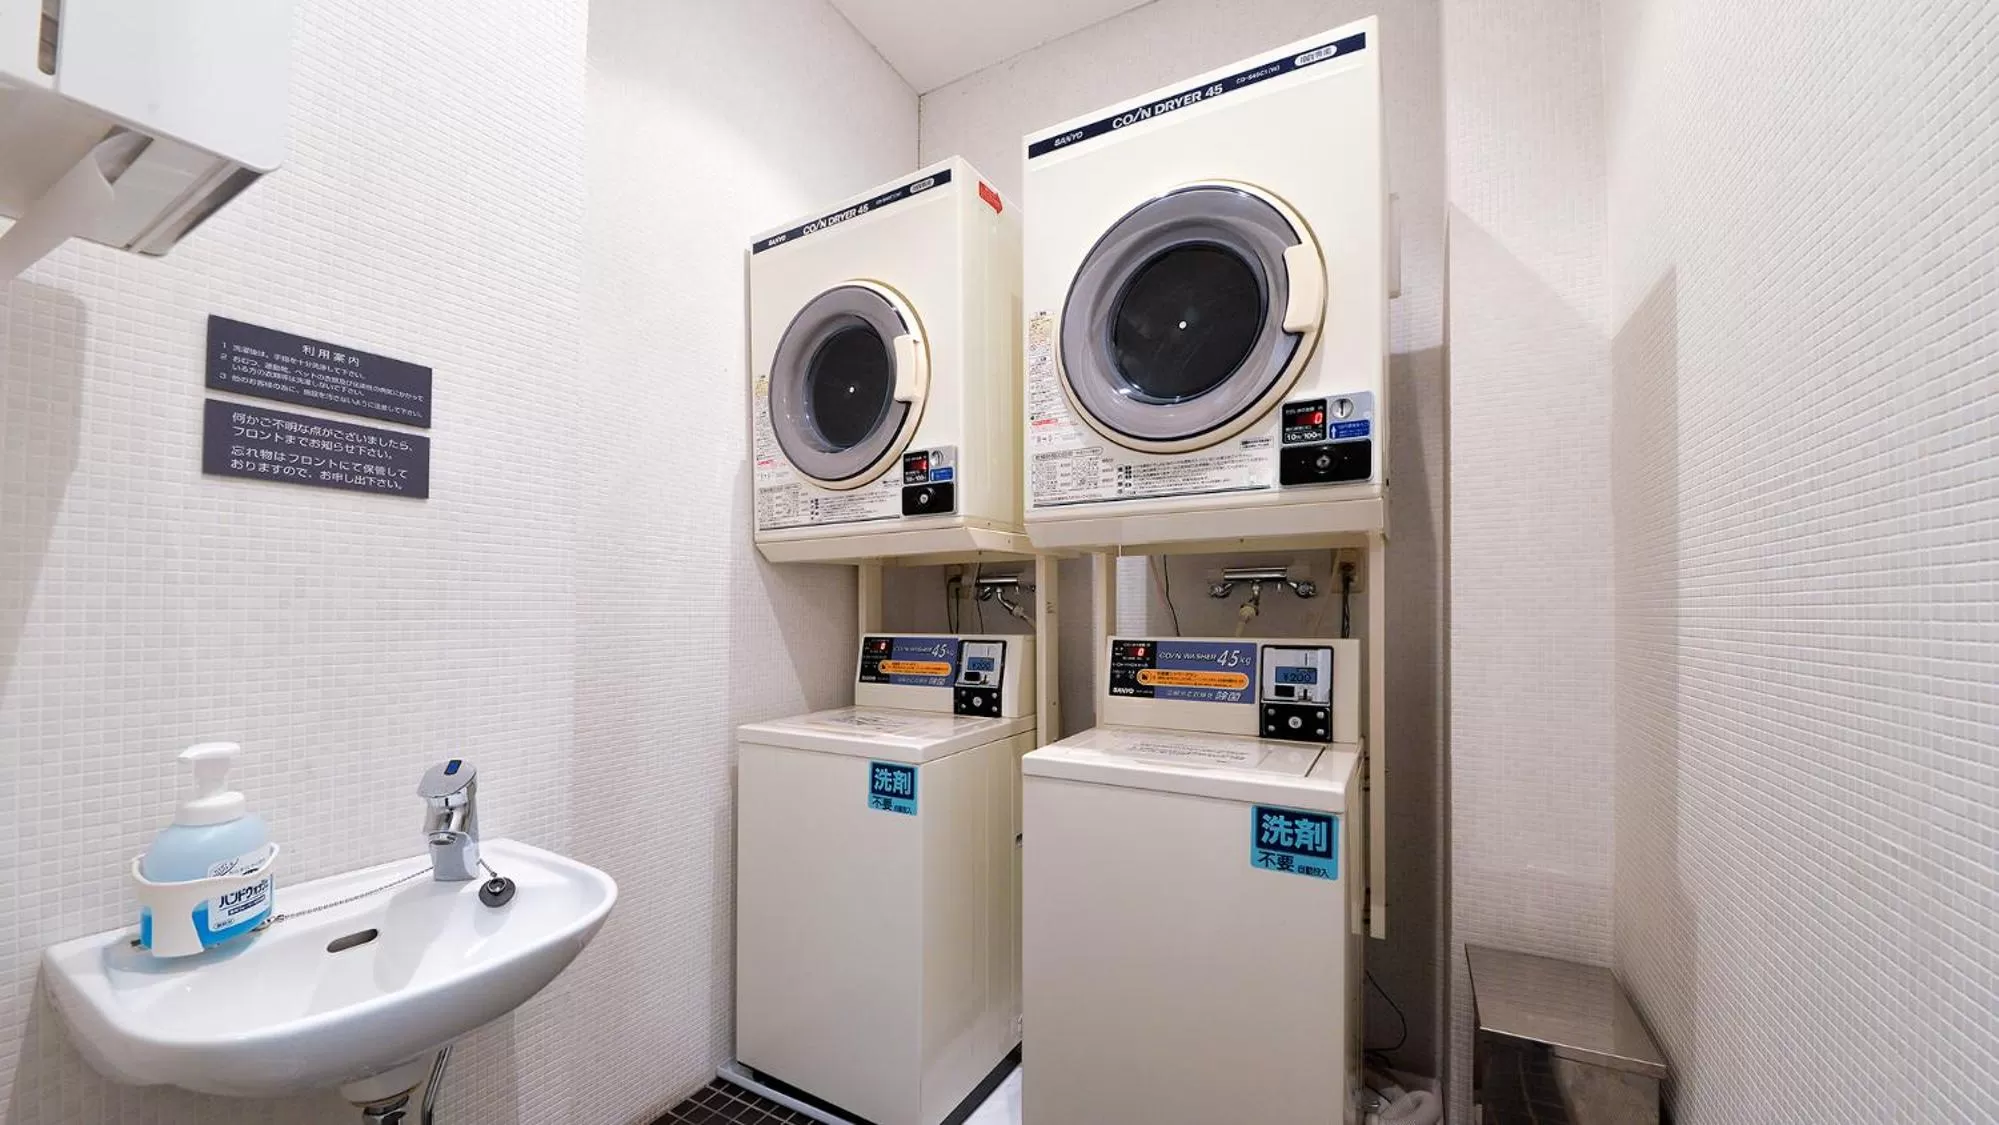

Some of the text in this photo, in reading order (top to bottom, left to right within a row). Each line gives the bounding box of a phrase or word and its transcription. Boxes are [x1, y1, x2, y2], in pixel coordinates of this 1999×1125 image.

[1053, 131, 1083, 147] SANYO
[1154, 90, 1202, 116] DRYER
[1205, 83, 1223, 97] 45
[828, 208, 856, 227] DRYER
[302, 344, 360, 367] 利用案内
[1314, 411, 1323, 424] 0
[231, 412, 414, 452] 何かご不明な点がございましたら、
[232, 426, 394, 460] フロントまでお知らせ下さい。
[230, 445, 409, 480] 忘れ物はフロントにて保管して
[230, 458, 403, 490] おりますので、お申し出下さい。
[1183, 652, 1217, 661] WASHER
[873, 768, 911, 795] 洗剤
[872, 795, 892, 811] 不要
[1261, 813, 1327, 852] 洗剤
[1257, 850, 1294, 872] 不要
